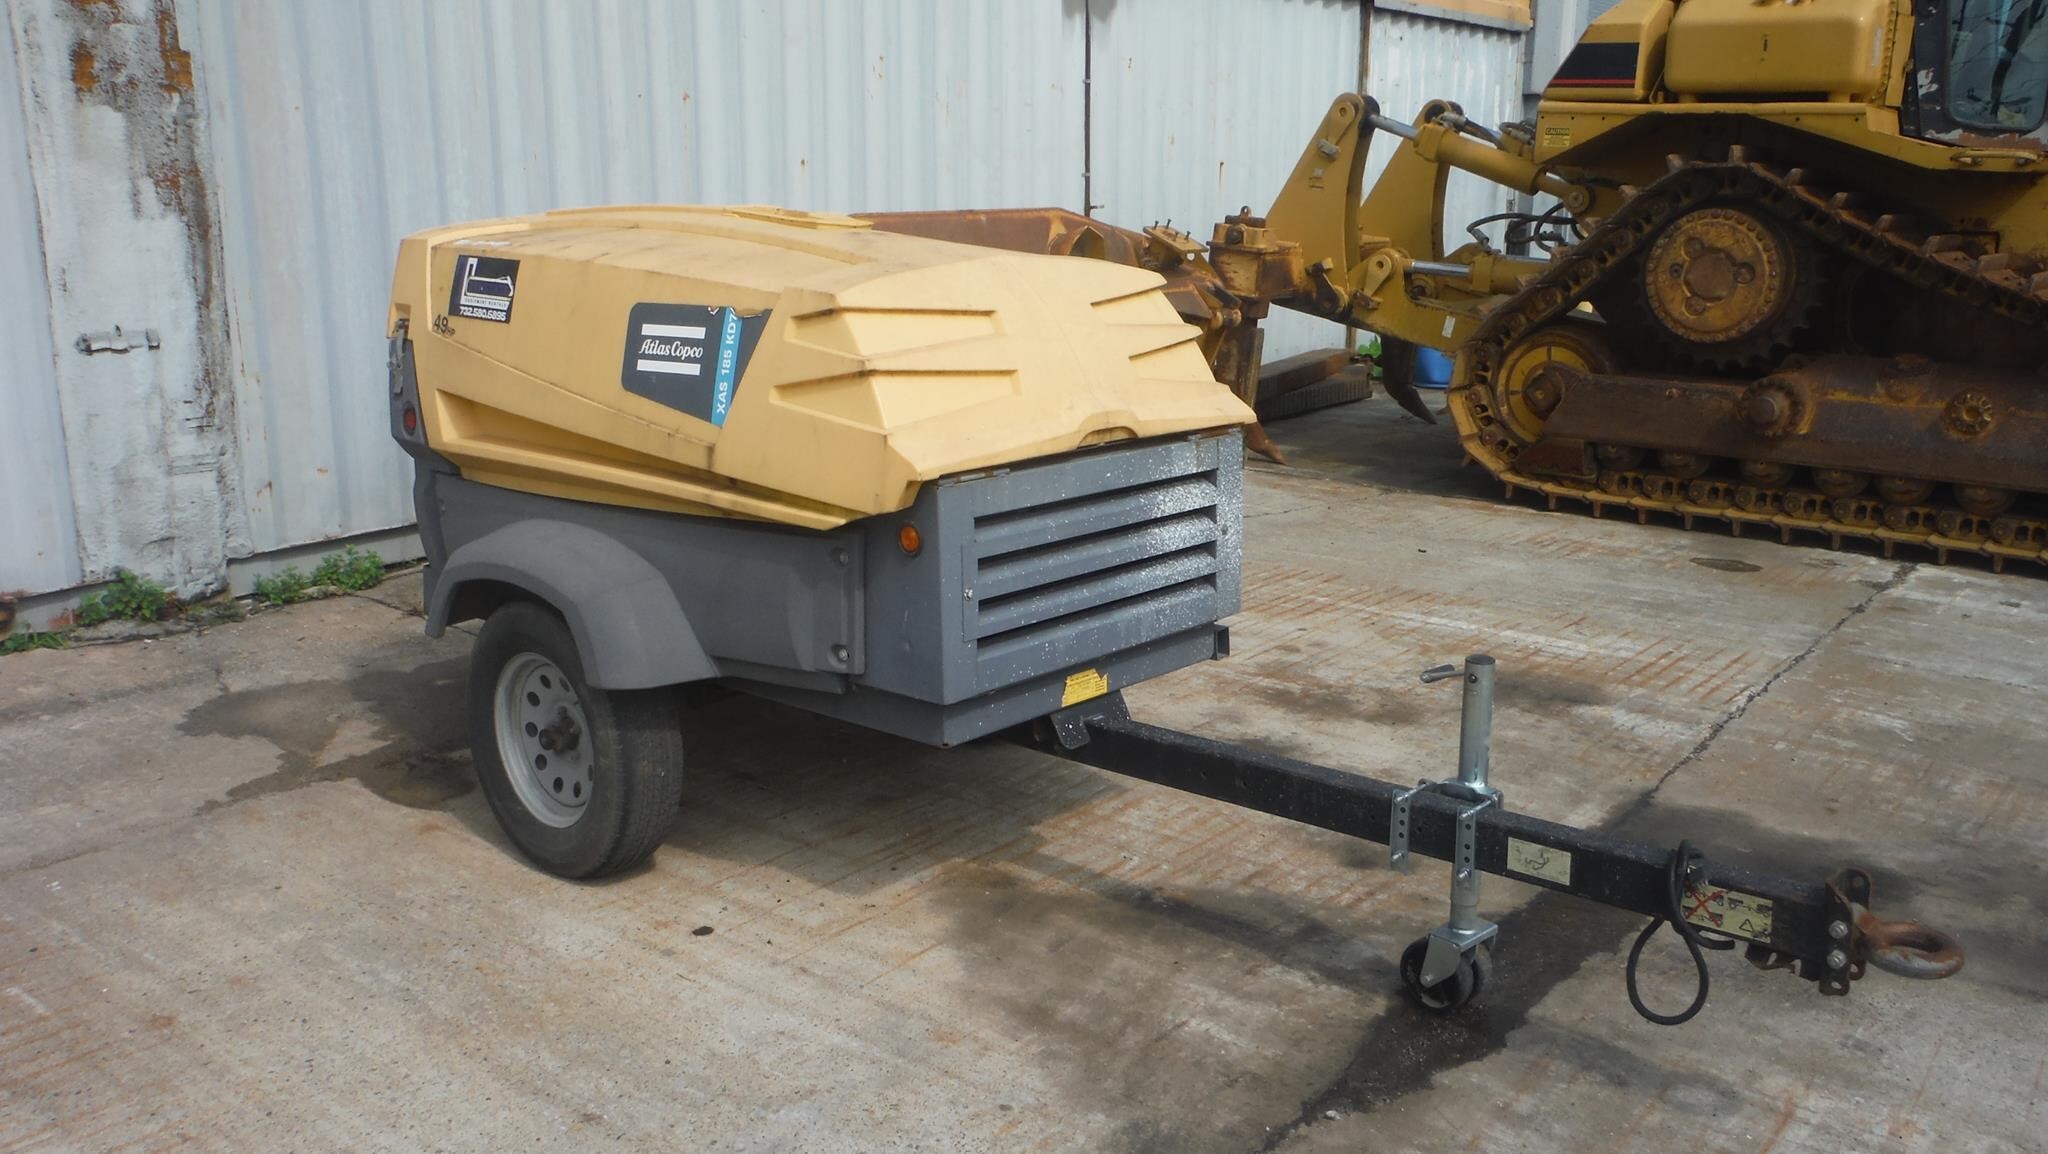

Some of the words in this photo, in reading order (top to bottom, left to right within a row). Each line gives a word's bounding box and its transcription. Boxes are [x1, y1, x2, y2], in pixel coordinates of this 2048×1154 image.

[638, 338, 671, 356] Atlas
[671, 340, 703, 360] Copco
[721, 350, 733, 375] 185
[716, 382, 728, 414] XAS
